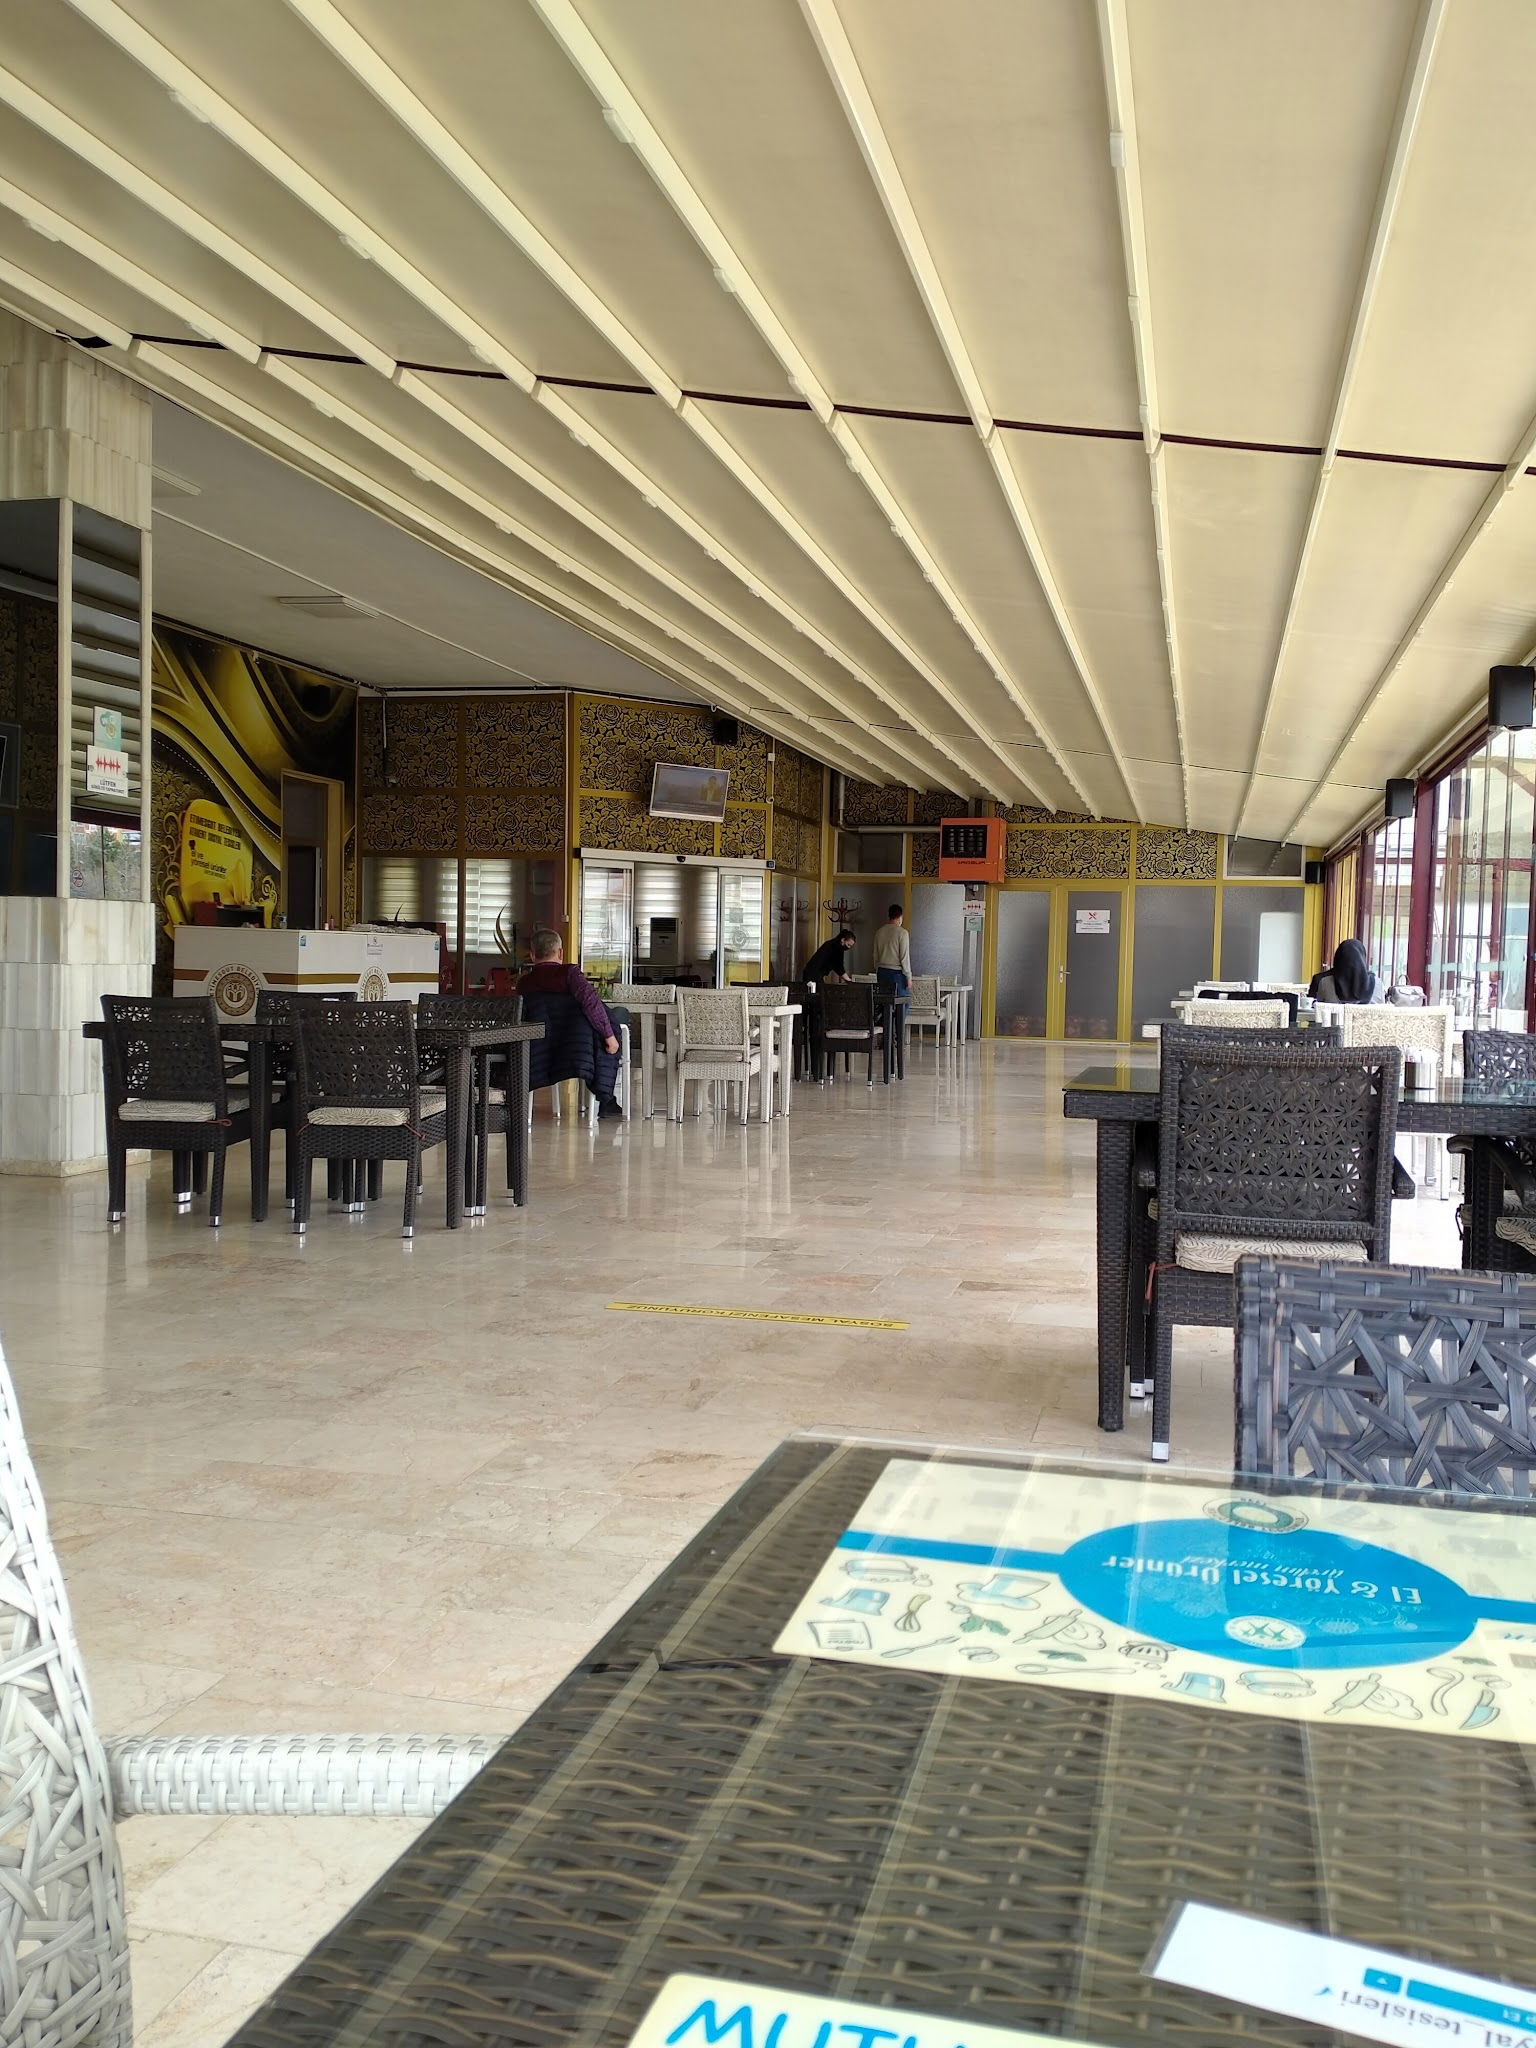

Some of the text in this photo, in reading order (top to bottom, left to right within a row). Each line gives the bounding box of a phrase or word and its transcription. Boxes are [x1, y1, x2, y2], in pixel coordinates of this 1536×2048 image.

[626, 1305, 725, 1315] KORUYUNUZ
[832, 1319, 893, 1328] SOSYAL
[1101, 1555, 1422, 1605] El & Yöresel Ürünler
